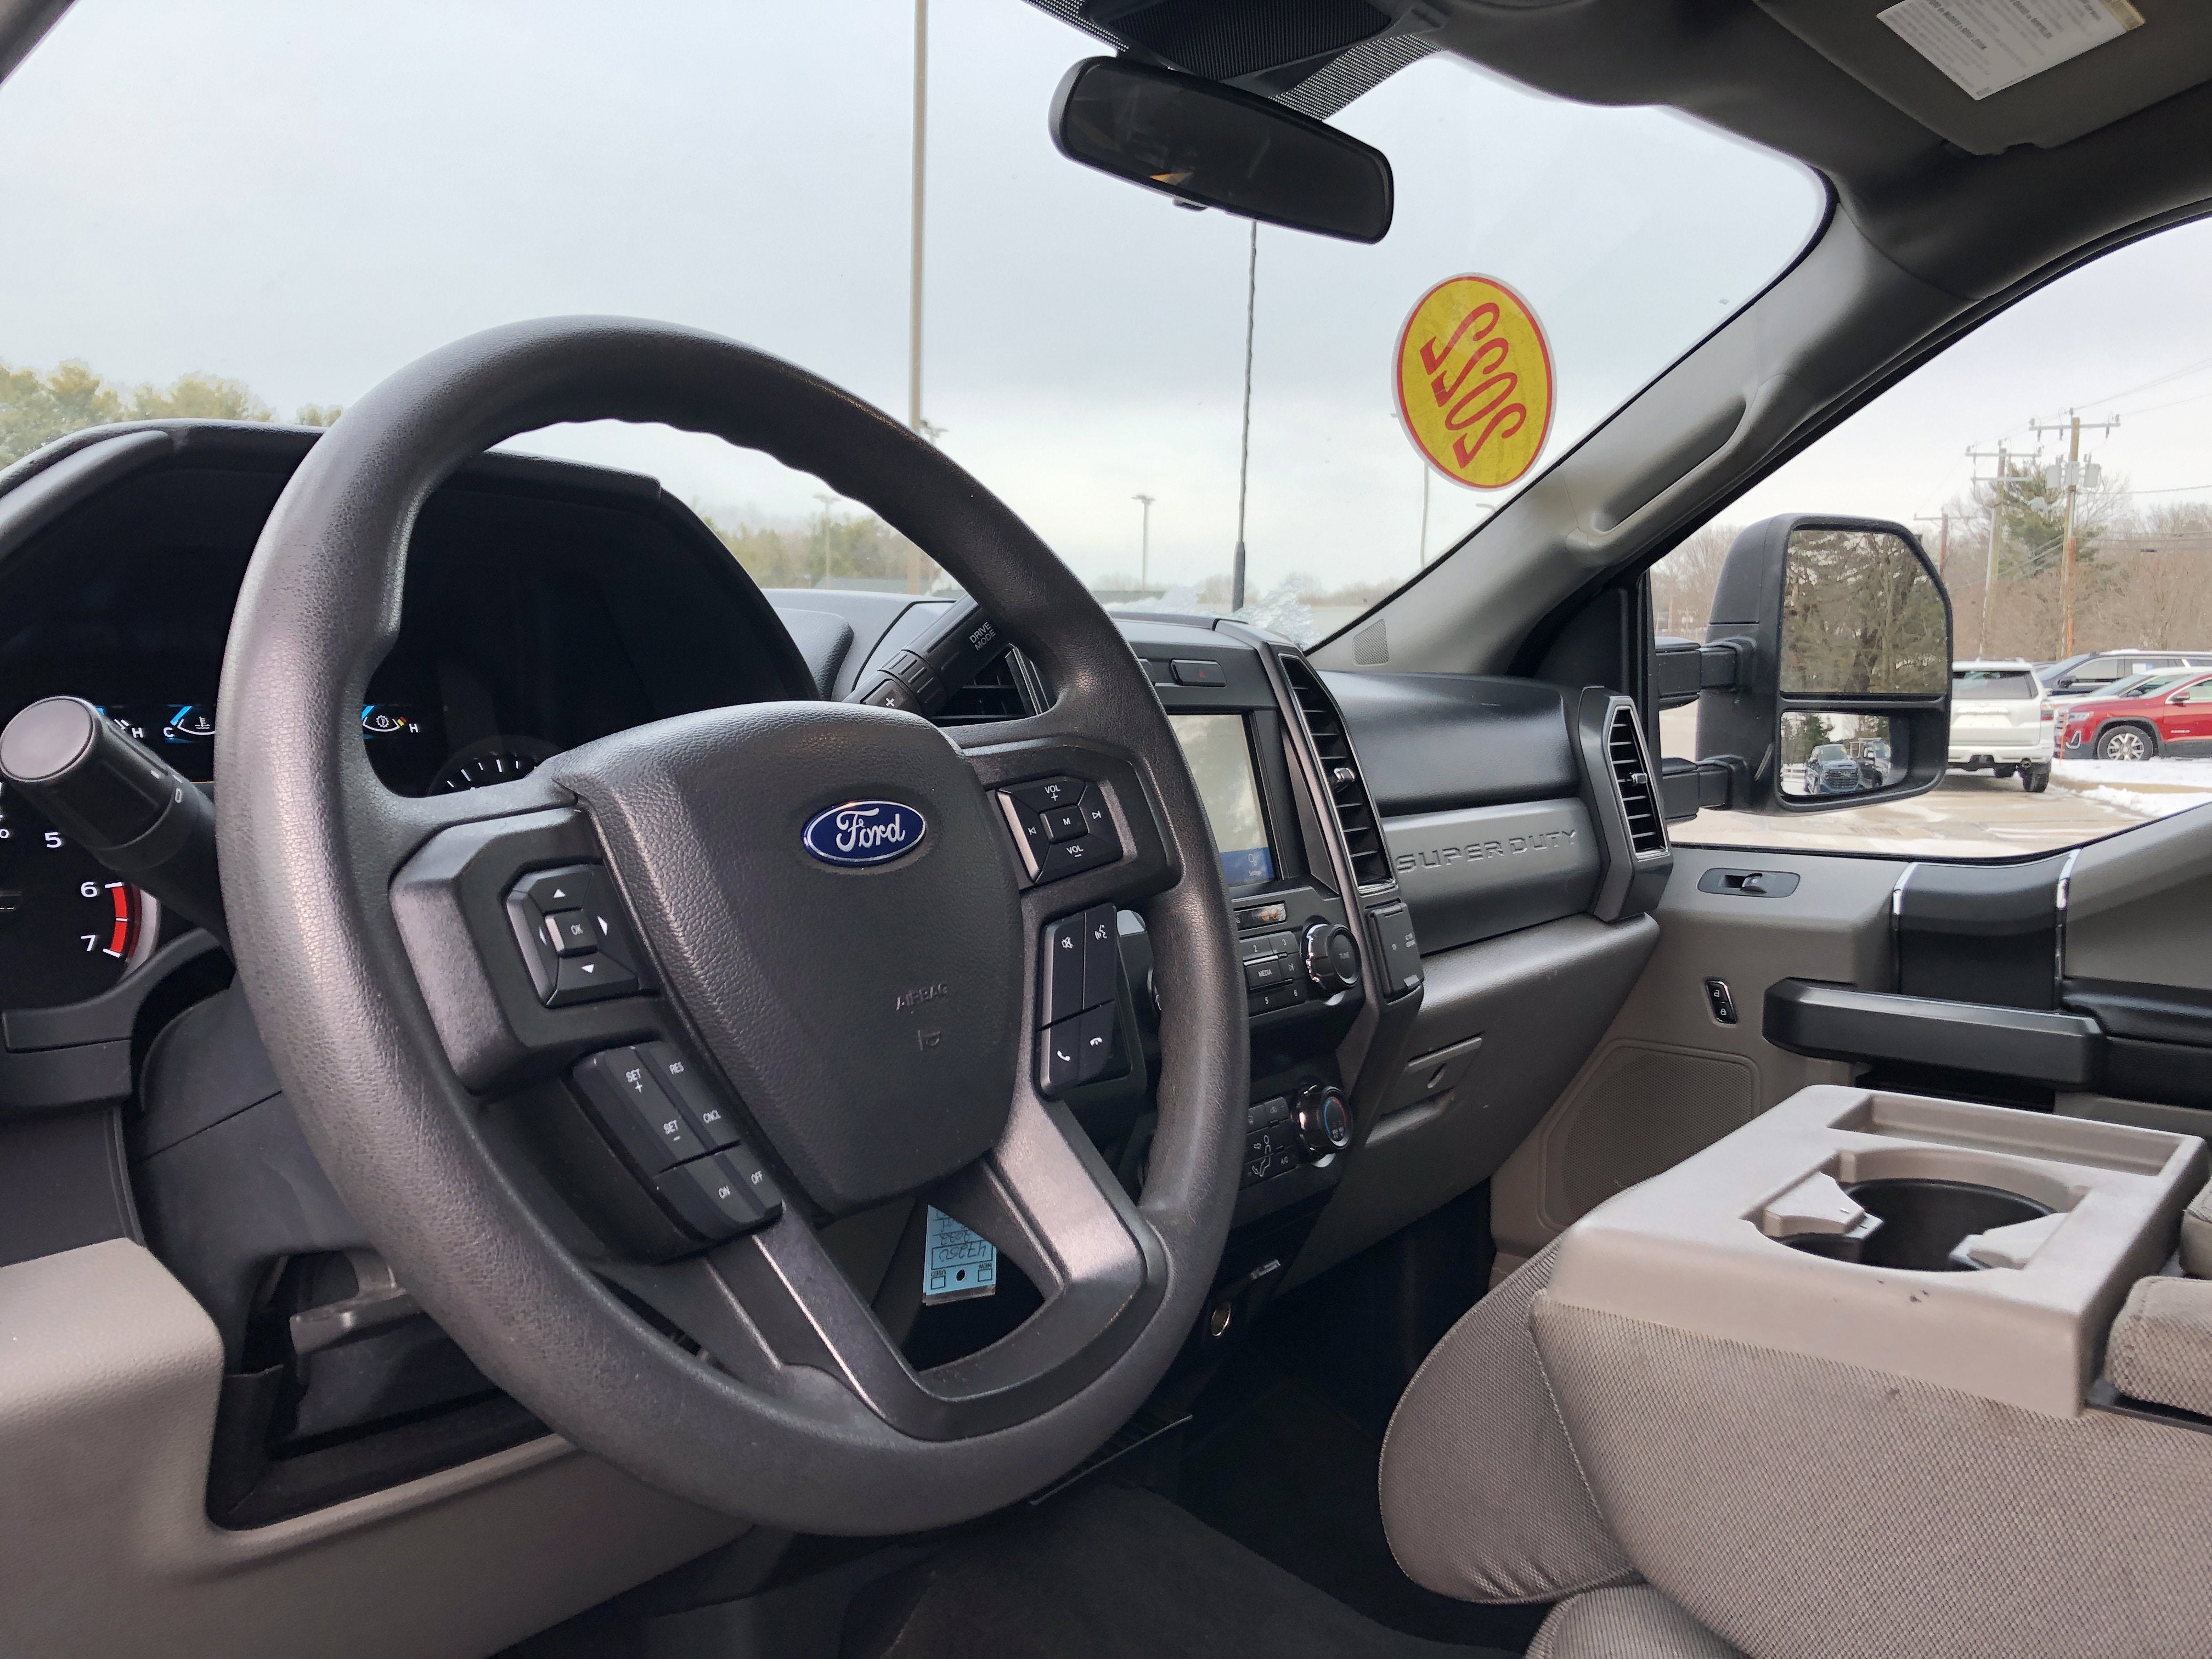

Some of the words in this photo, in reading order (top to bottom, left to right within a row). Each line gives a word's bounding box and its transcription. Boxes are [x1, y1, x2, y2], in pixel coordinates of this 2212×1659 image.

[969, 622, 991, 643] DRIVE
[974, 629, 996, 651] MODE
[132, 727, 144, 738] H
[163, 727, 174, 737] C
[409, 723, 419, 733] H
[1044, 785, 1061, 794] VOL
[1062, 817, 1071, 826] M
[836, 808, 906, 853] Ford
[44, 832, 61, 848] 5
[1066, 845, 1084, 854] VOL
[1395, 840, 1504, 874] SUPER
[1509, 829, 1577, 855] DUTY
[80, 882, 98, 898] 6
[571, 924, 584, 935] OK
[80, 934, 96, 951] 7
[1258, 969, 1272, 977] MEDIA
[669, 1062, 685, 1074] RES
[625, 1068, 641, 1082] SET
[703, 1109, 721, 1124] CNCL
[663, 1120, 678, 1135] SET
[751, 1170, 763, 1185] OFF
[718, 1186, 731, 1199] ON
[930, 1269, 946, 1277] USED
